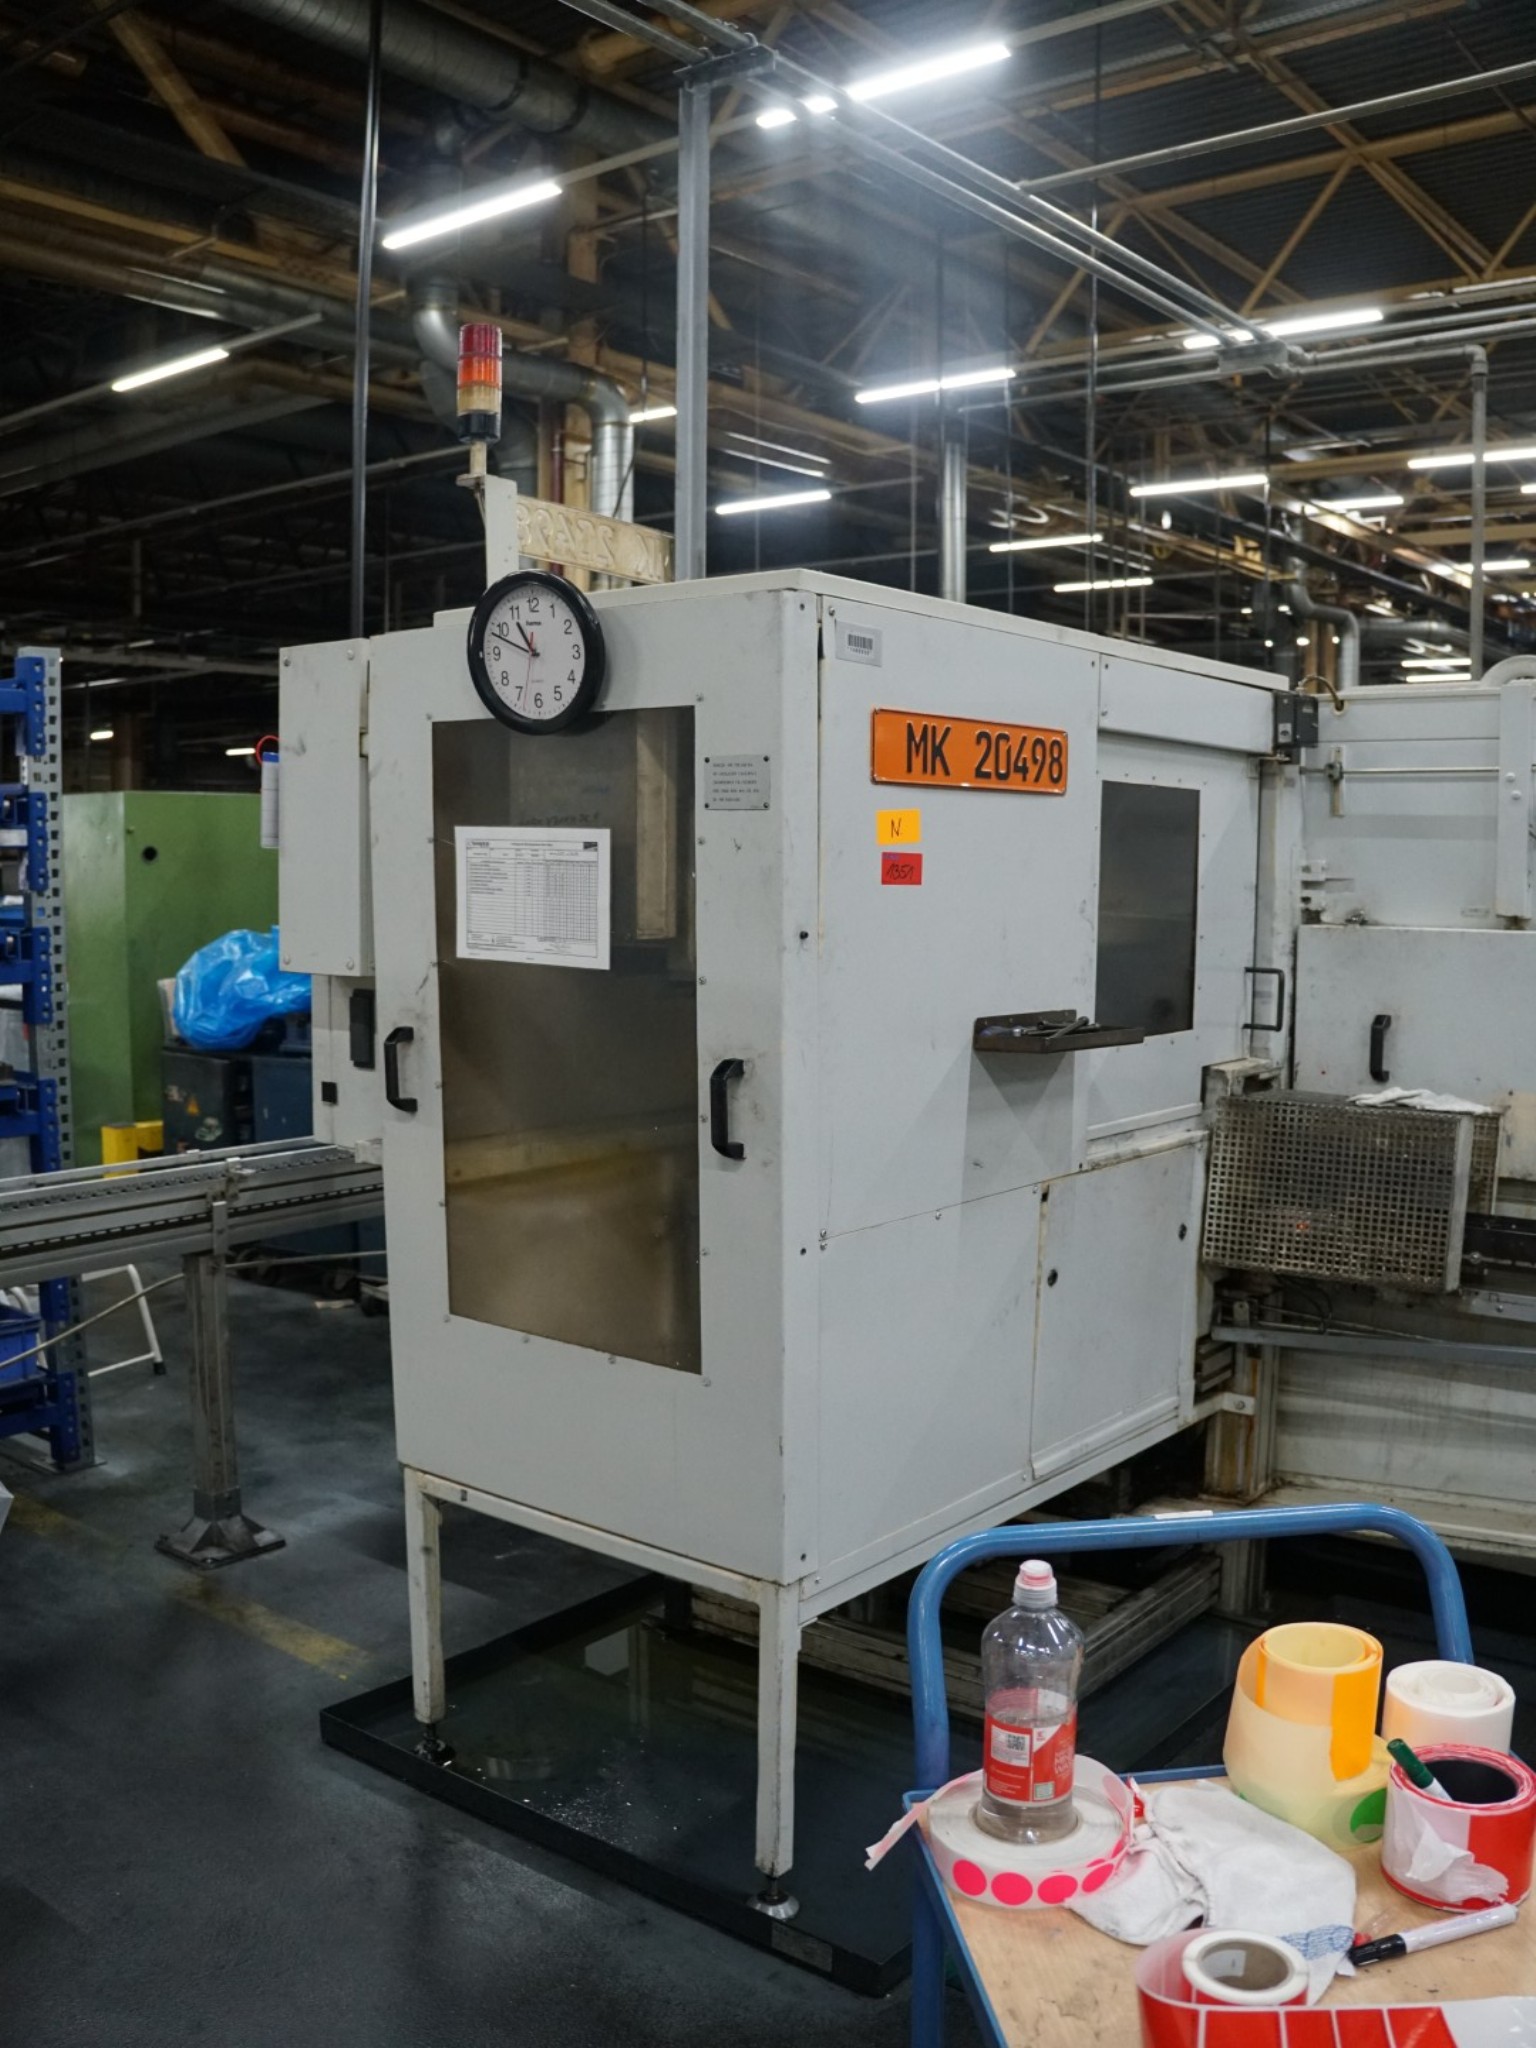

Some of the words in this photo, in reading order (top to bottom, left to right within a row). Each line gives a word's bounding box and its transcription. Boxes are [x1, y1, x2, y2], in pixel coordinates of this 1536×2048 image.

[509, 605, 520, 620] 11
[526, 597, 540, 613] 12
[496, 621, 510, 637] 10
[563, 618, 573, 635] 2
[492, 645, 501, 661] 9
[572, 643, 581, 660] 3
[501, 670, 510, 687] 8
[567, 669, 576, 684] 4
[515, 685, 523, 701] 7
[533, 692, 544, 709] 6
[553, 685, 562, 701] 5
[906, 721, 952, 776] MK
[974, 730, 1063, 784] 20498
[890, 817, 902, 839] N
